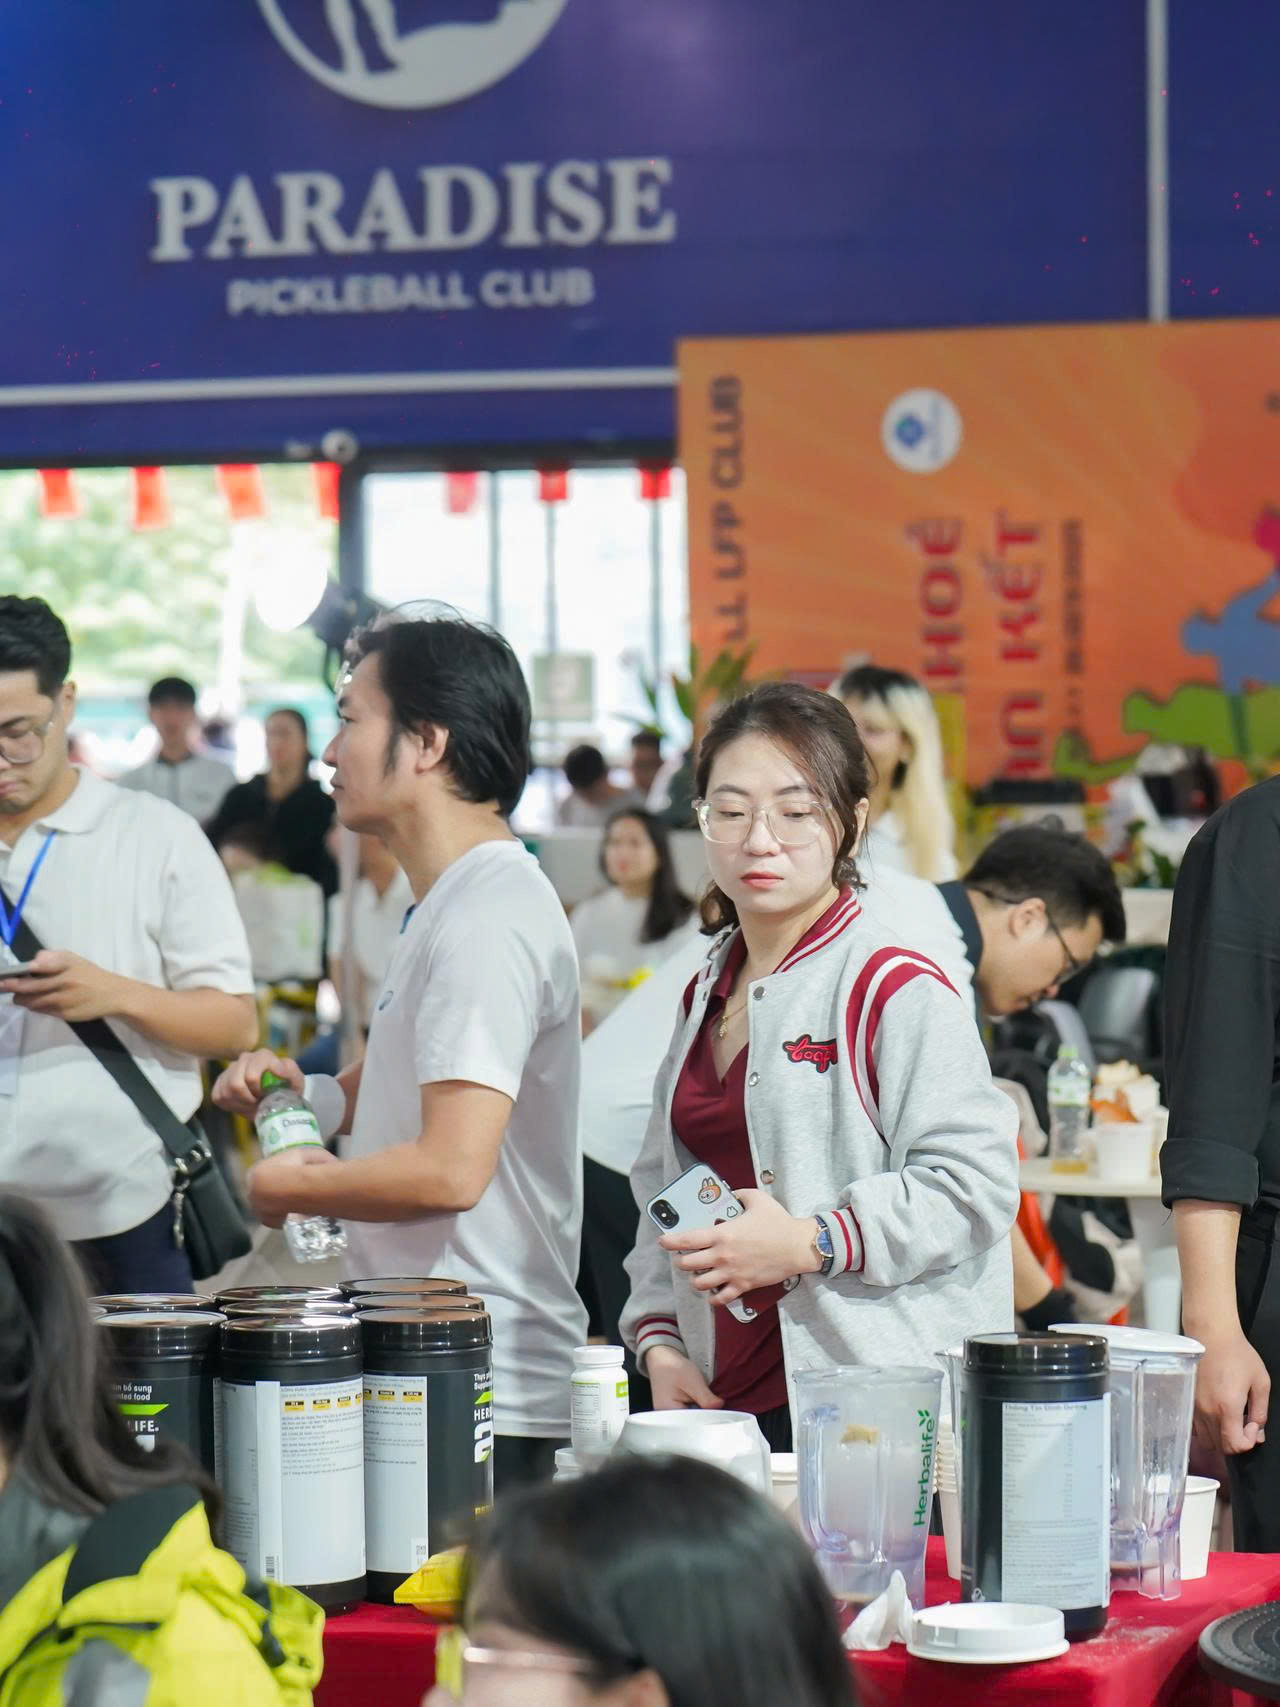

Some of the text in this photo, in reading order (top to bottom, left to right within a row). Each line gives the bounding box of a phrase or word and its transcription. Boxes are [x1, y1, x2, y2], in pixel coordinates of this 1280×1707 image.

[149, 157, 678, 263] PARADISE
[226, 266, 595, 317] PICKLEBALL CLUB
[709, 375, 743, 489] CLUB
[133, 1385, 152, 1393] sung
[912, 1418, 936, 1526] Herbalife
